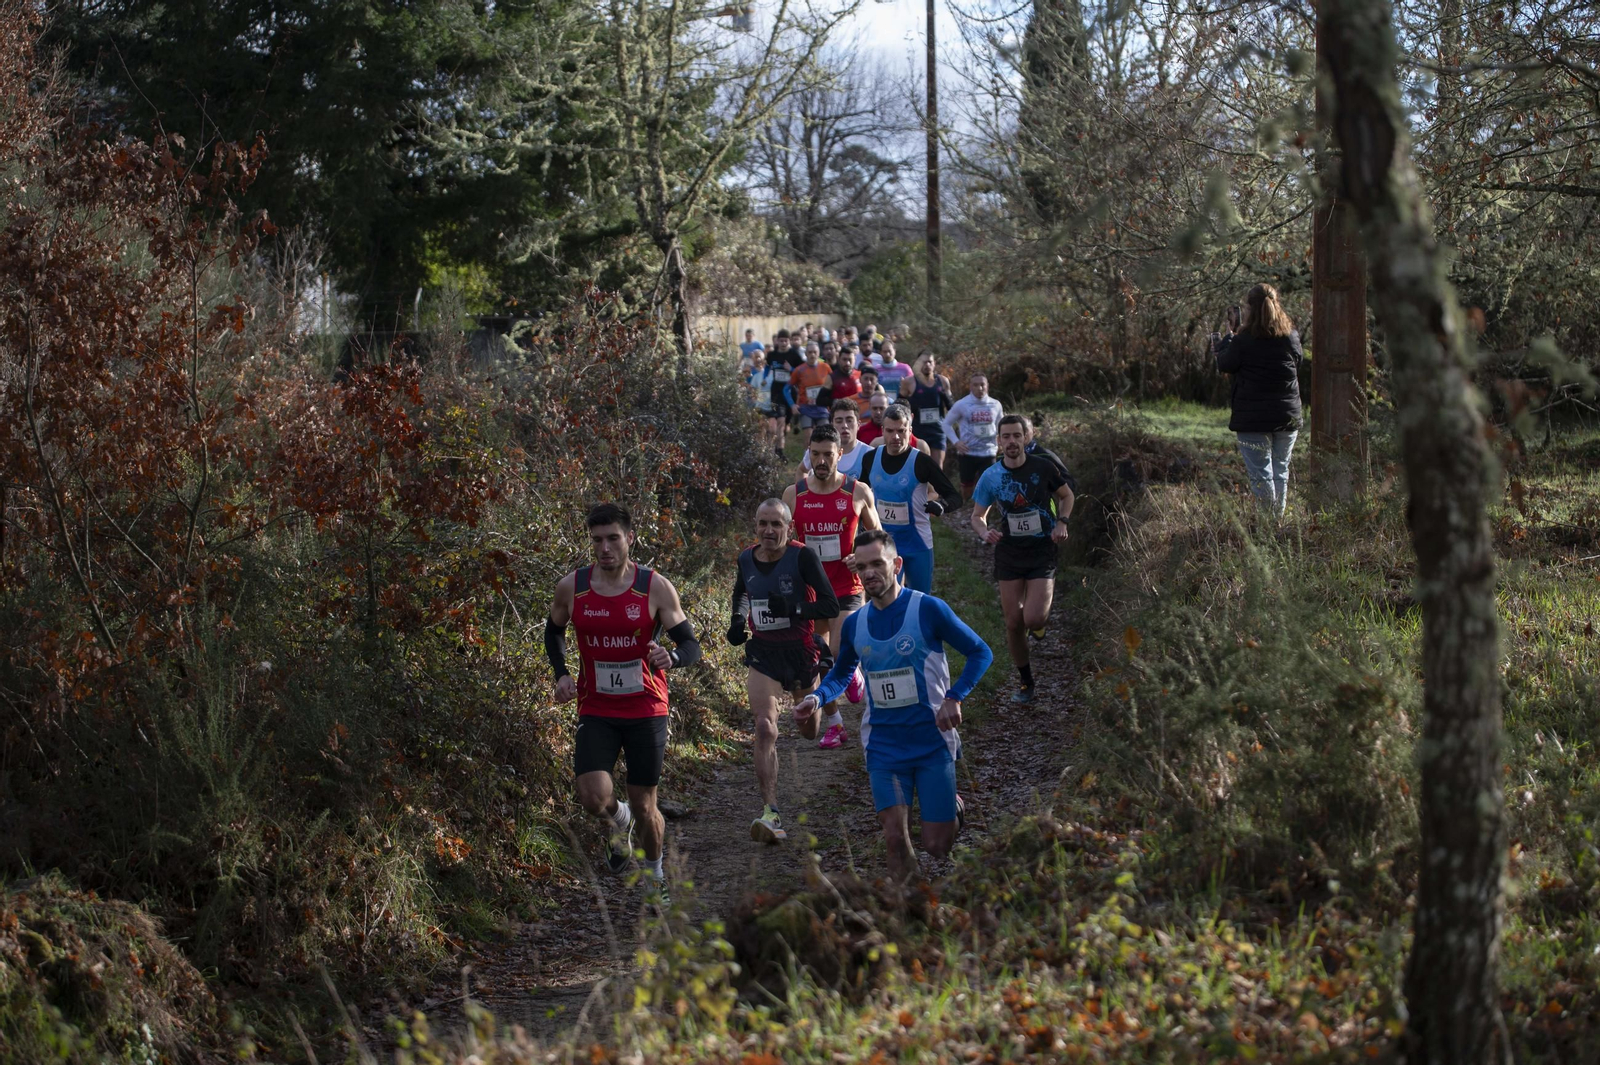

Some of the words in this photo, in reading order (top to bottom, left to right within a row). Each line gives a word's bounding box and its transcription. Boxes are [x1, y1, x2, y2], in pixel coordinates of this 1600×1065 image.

[884, 509, 896, 520] 24
[804, 522, 815, 532] LA
[818, 522, 844, 532] GANGA
[1018, 520, 1030, 531] 45
[818, 544, 822, 556] 1
[584, 609, 610, 618] aqualia
[586, 635, 600, 647] LA
[603, 636, 638, 648] GANGA
[610, 673, 624, 688] 14
[882, 683, 896, 700] 19
